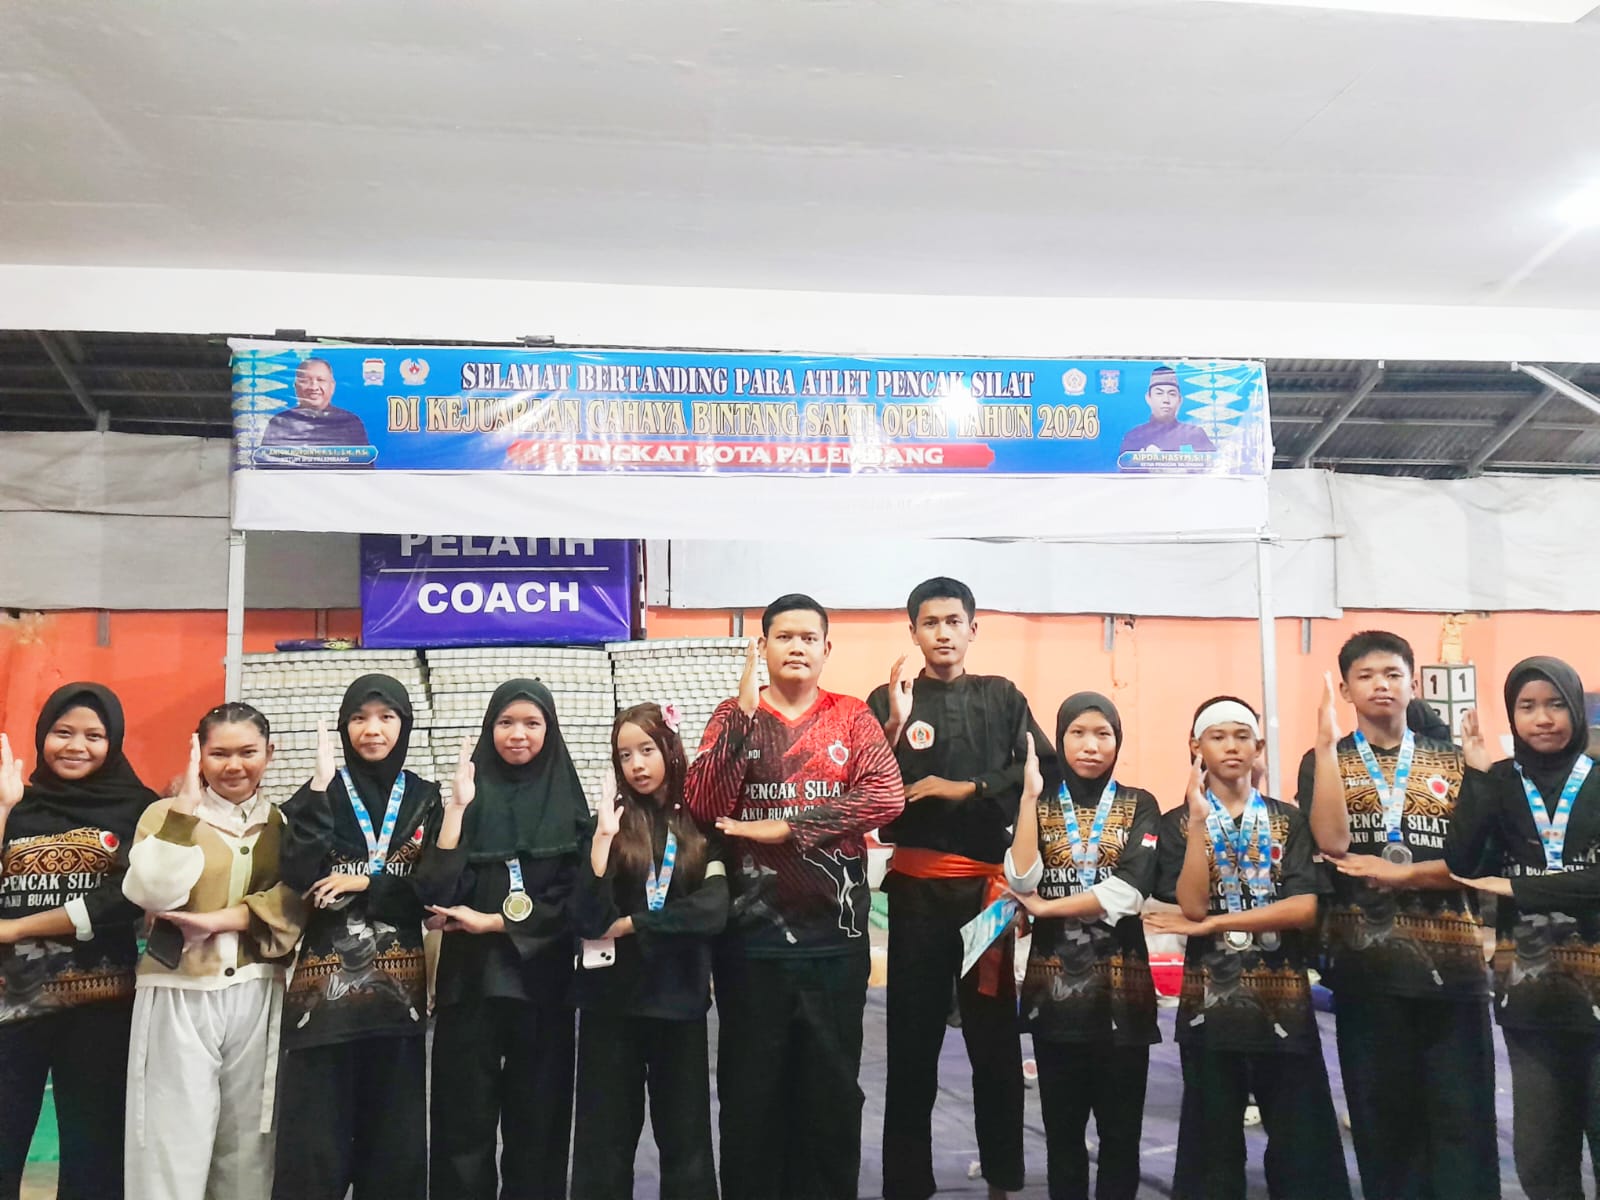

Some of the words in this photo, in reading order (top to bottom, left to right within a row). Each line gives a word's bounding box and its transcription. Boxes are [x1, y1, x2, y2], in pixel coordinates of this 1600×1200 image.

[461, 361, 571, 391] SELAMAT
[577, 363, 728, 395] BERTANDING
[734, 367, 796, 396] PARA
[801, 369, 871, 397] ATLET
[876, 370, 965, 398] PENCAK
[971, 371, 1034, 398] SILAT
[387, 396, 419, 432] DI
[426, 396, 582, 434] KEJUARAAN
[587, 399, 687, 436] CAHAYA
[692, 401, 800, 437] BINTANG
[804, 403, 877, 438] SAKTI
[881, 404, 948, 438] OPEN
[1036, 404, 1100, 440] 2026
[695, 445, 773, 465] KOTA
[775, 446, 945, 466] PALEMBANG
[418, 581, 580, 614] COACH
[1430, 674, 1437, 694] 1
[1459, 672, 1466, 693] 1
[741, 808, 764, 821] AKU
[1348, 812, 1388, 830] PENCA
[1407, 814, 1451, 835] SILAT
[331, 861, 374, 875] PENCA
[0, 874, 60, 893] PENCAK
[68, 872, 109, 889] SILA
[27, 894, 61, 907] BUMI
